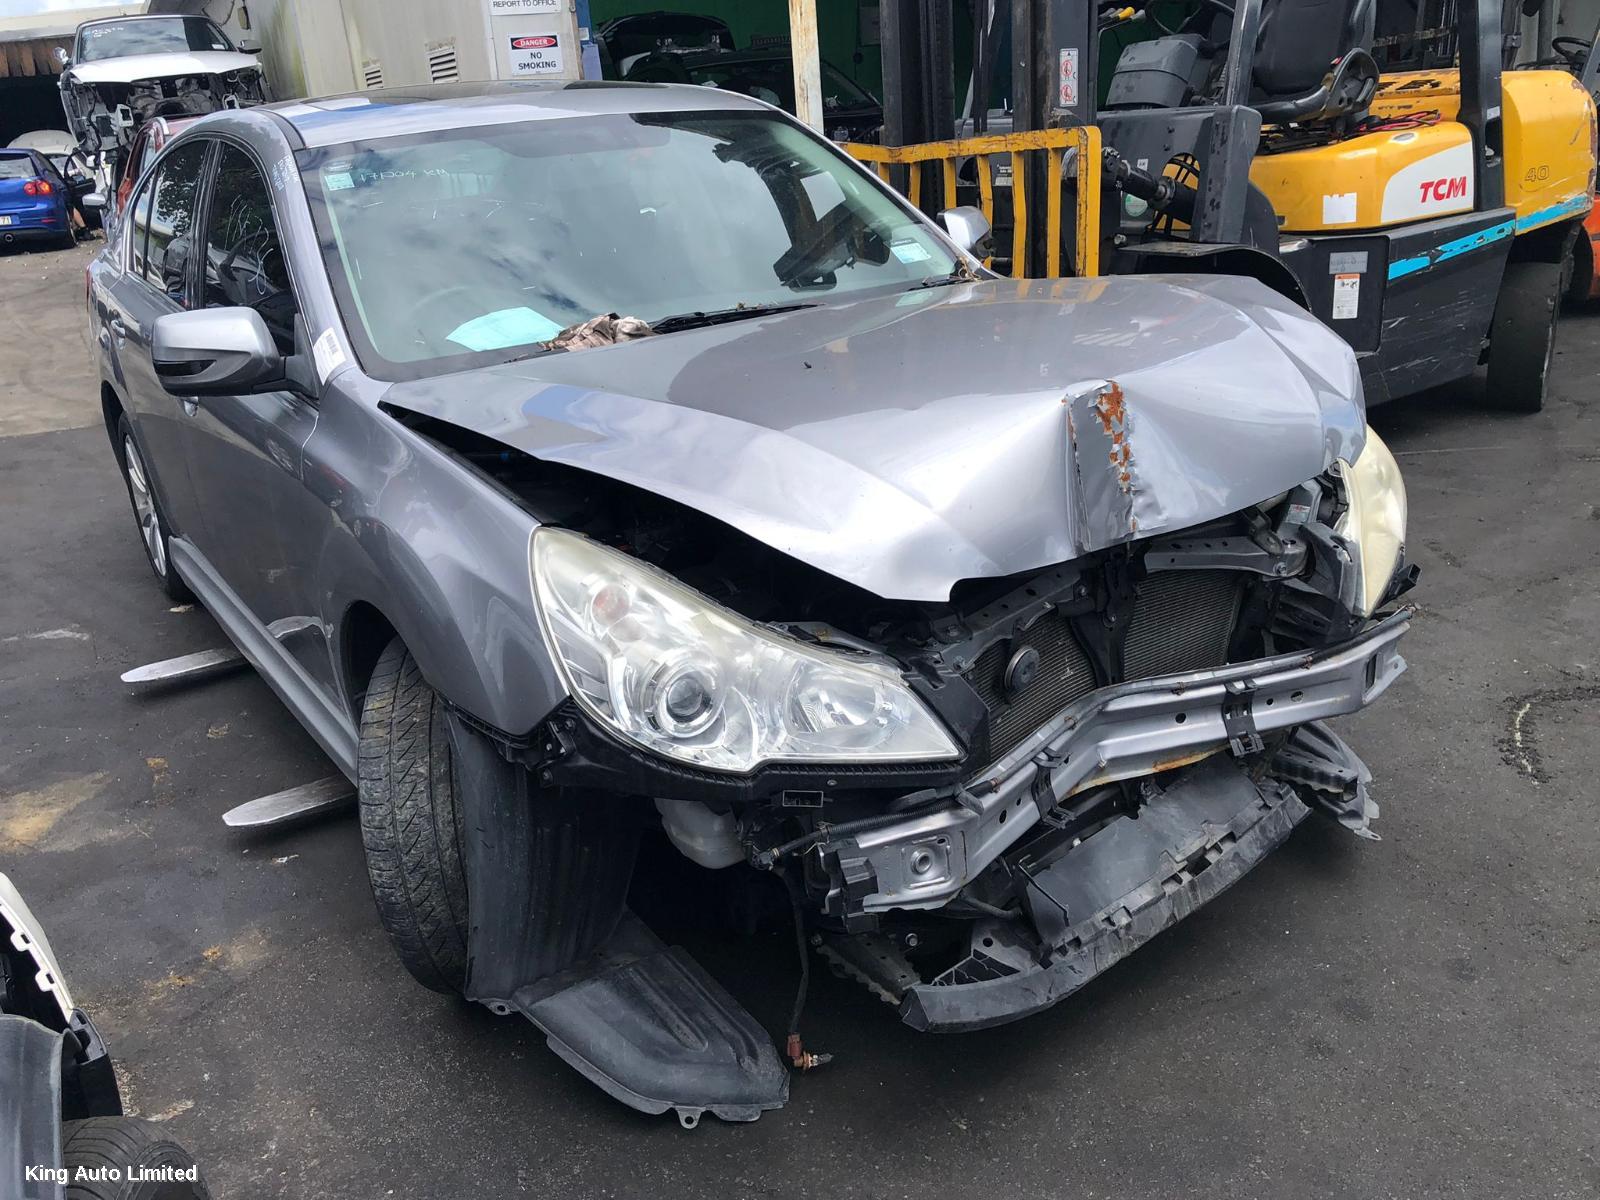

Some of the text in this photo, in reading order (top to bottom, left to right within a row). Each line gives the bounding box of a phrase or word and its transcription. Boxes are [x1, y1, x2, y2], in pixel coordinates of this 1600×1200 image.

[520, 39, 548, 47] DANGER
[518, 60, 557, 70] SMOKING
[1524, 165, 1549, 182] 40
[1419, 176, 1467, 203] TCM
